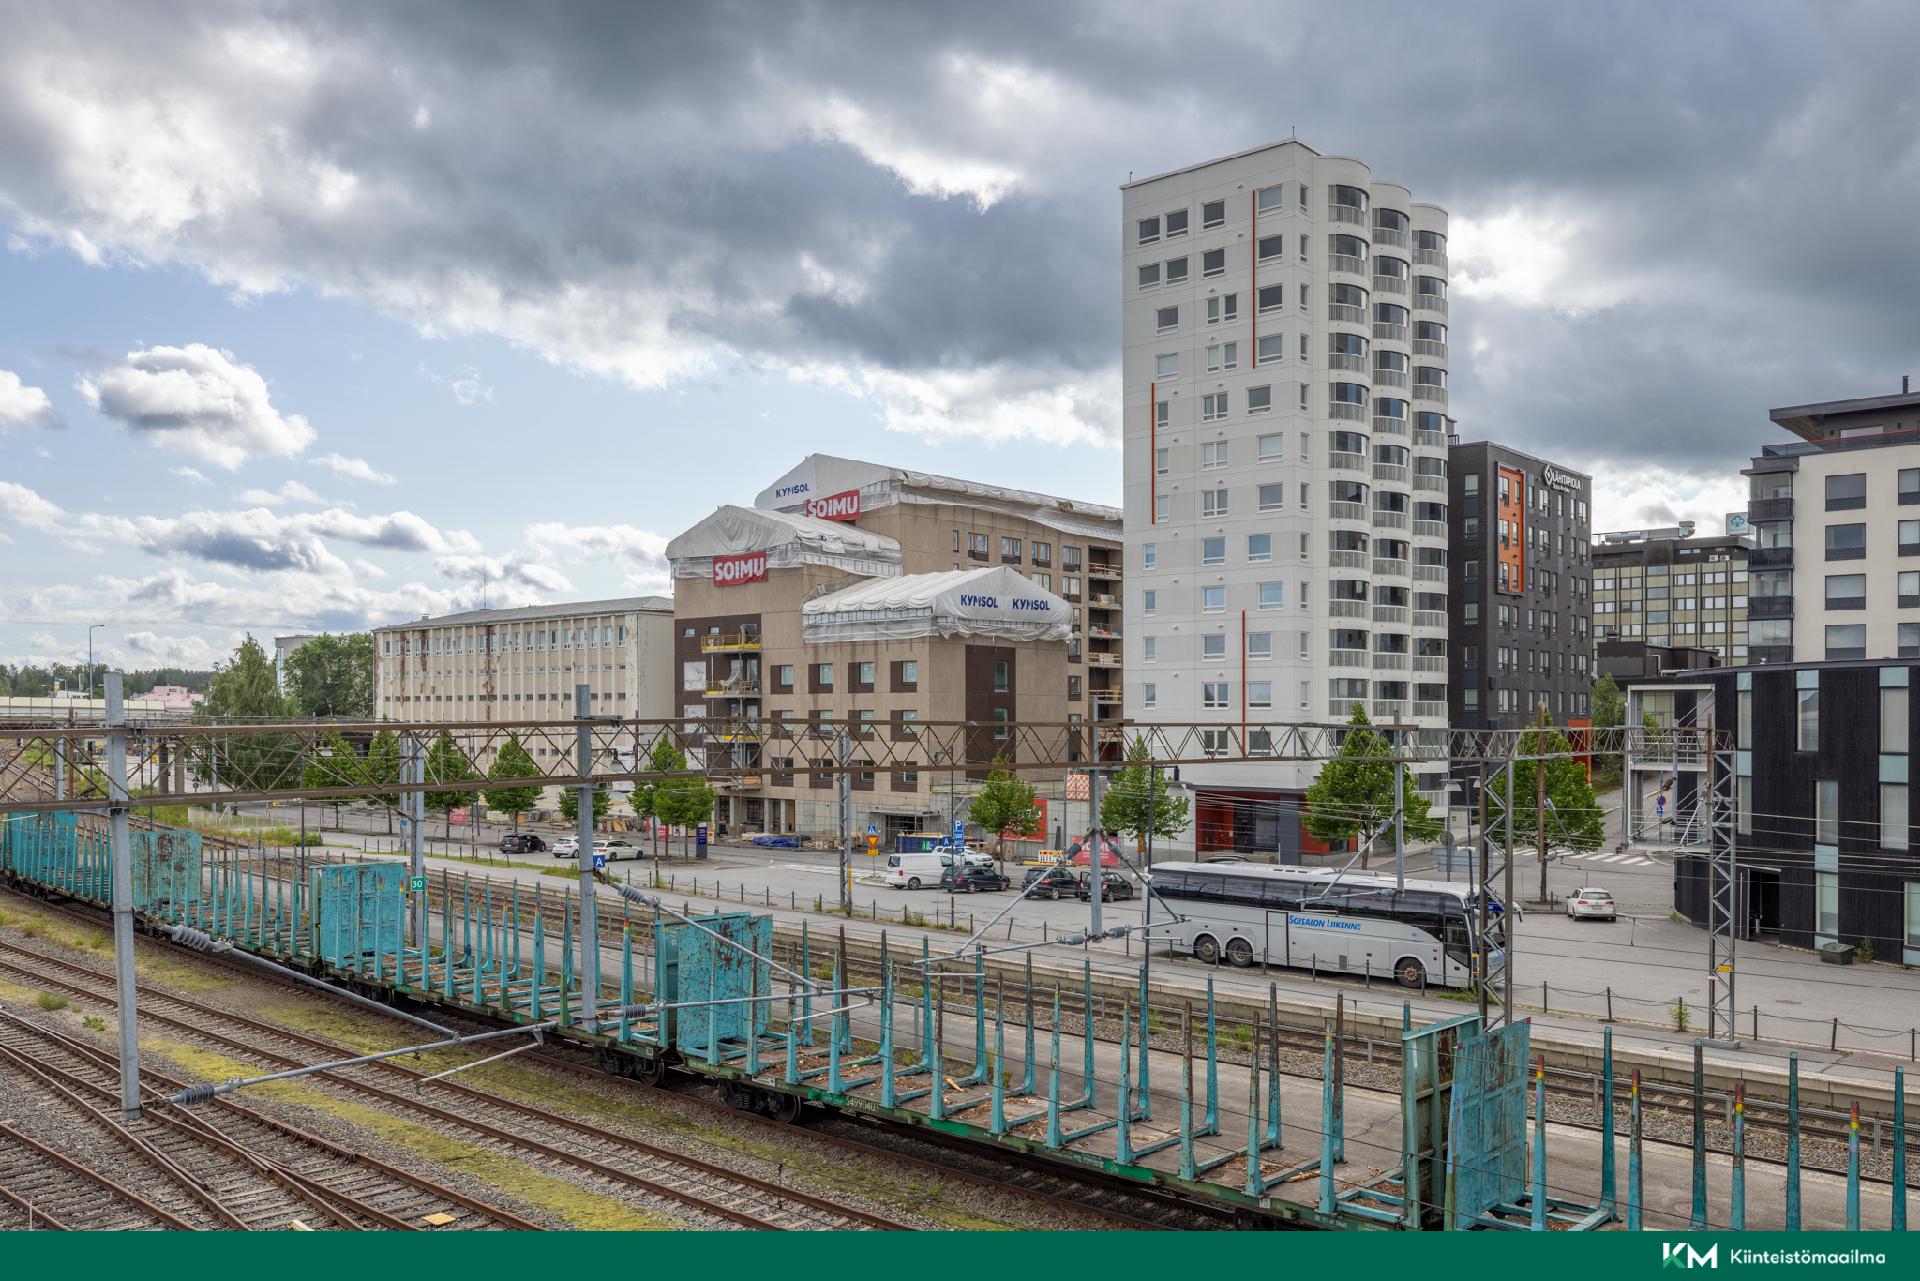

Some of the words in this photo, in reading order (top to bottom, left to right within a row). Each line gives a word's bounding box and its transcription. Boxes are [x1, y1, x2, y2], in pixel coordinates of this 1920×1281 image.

[807, 495, 859, 519] SOIMU
[714, 557, 765, 581] SOIMU
[960, 594, 999, 609] KYMSOL
[1012, 598, 1051, 611] KYMSOL
[955, 820, 962, 830] P
[595, 857, 603, 866] A
[412, 880, 423, 889] 30
